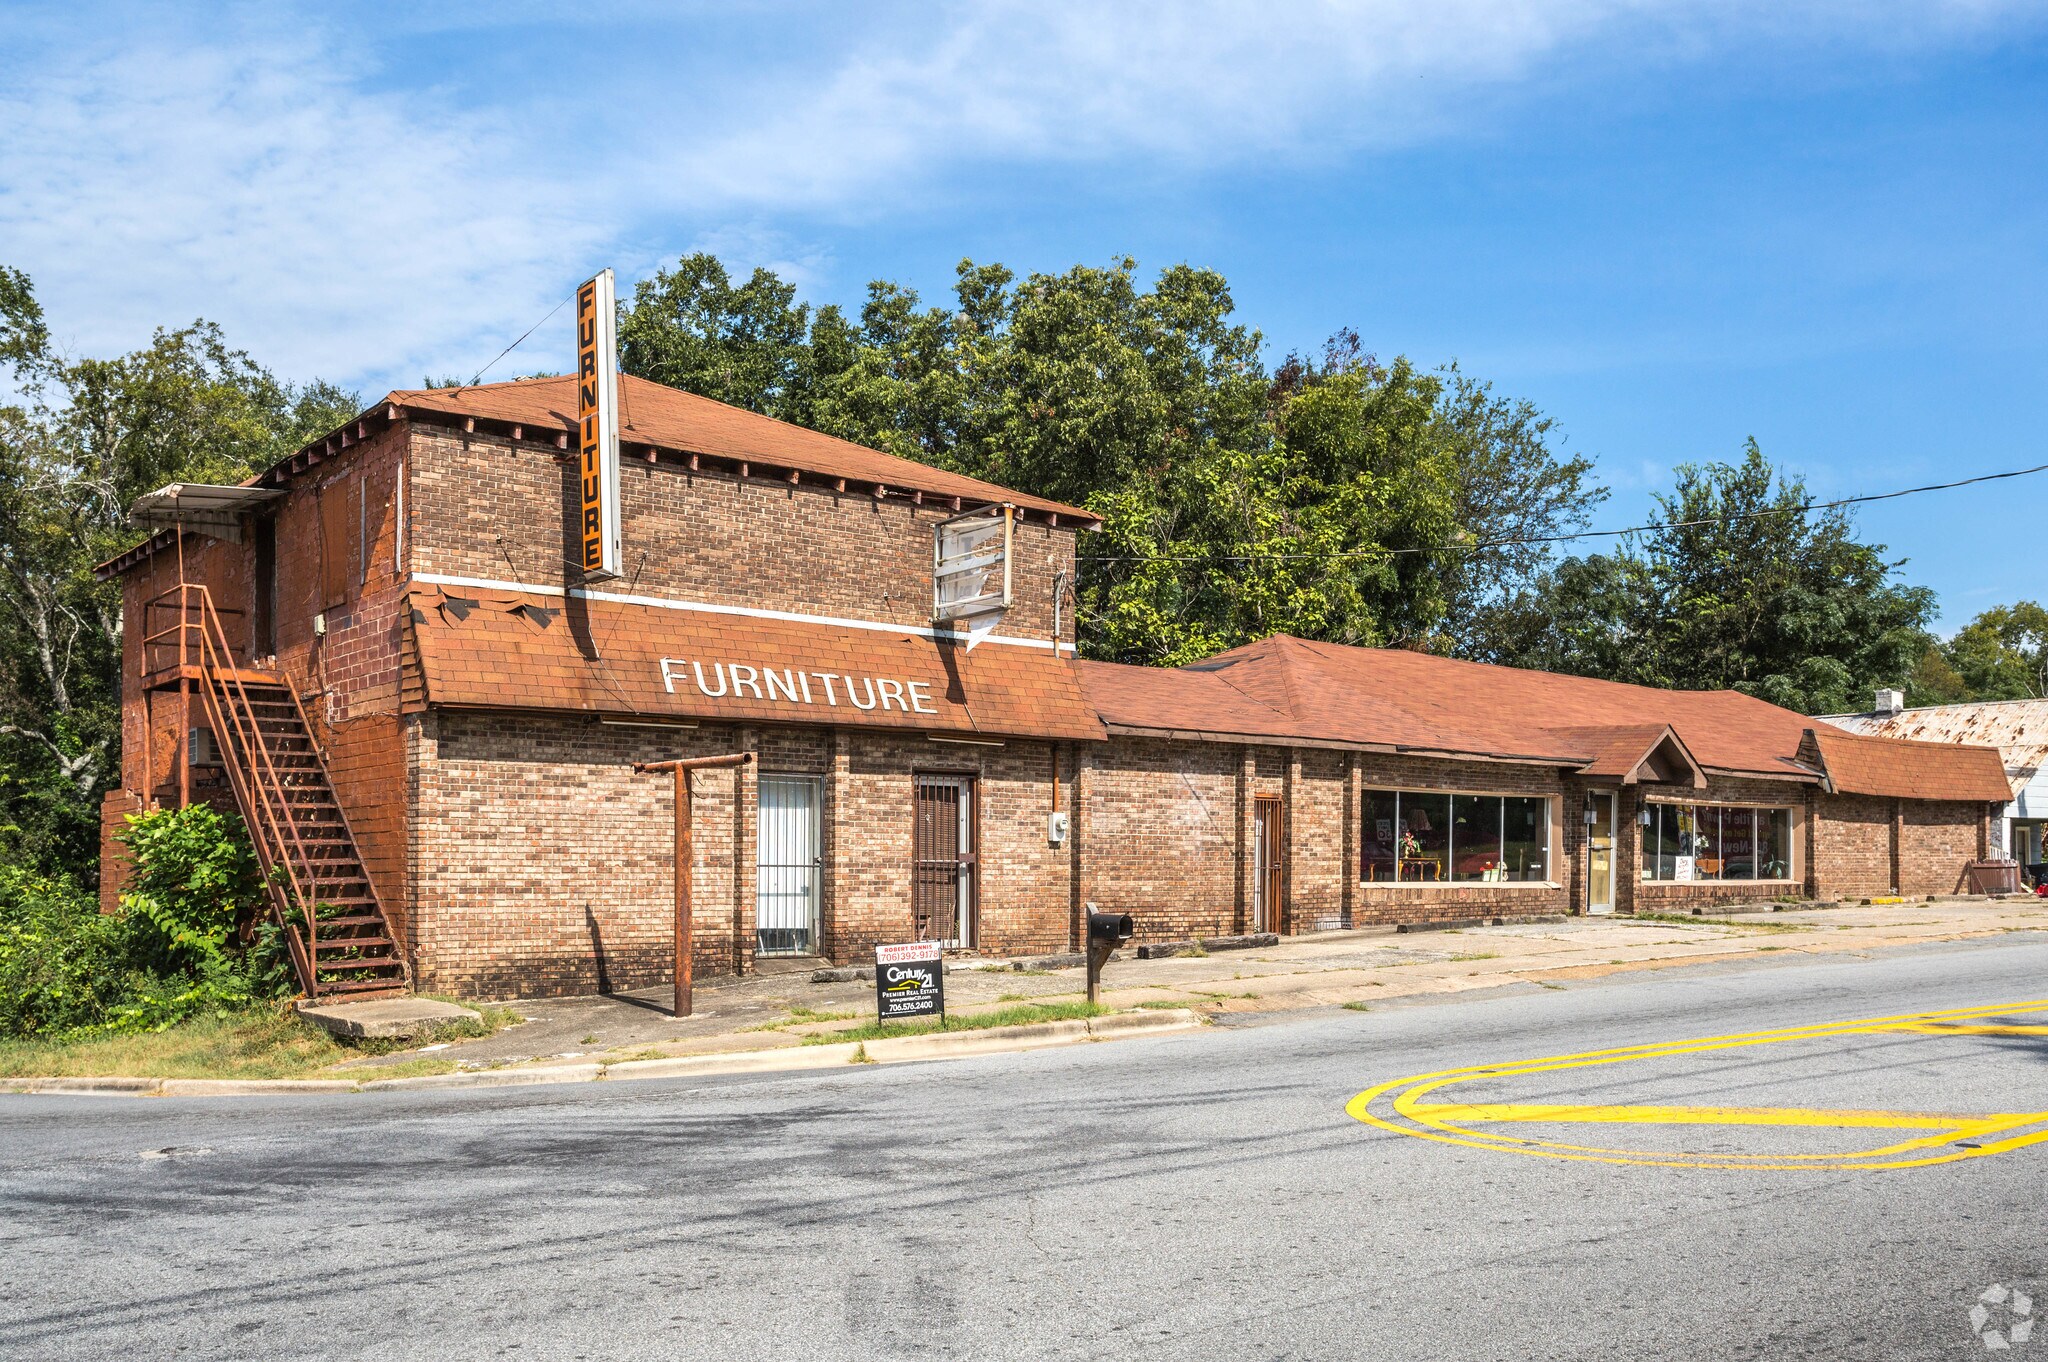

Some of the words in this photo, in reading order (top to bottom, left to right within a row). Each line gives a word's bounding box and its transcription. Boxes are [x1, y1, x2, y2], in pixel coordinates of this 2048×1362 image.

[580, 286, 600, 567] FURNITURE
[659, 657, 938, 714] FURNITURE
[887, 966, 925, 982] Century
[921, 973, 932, 988] 21
